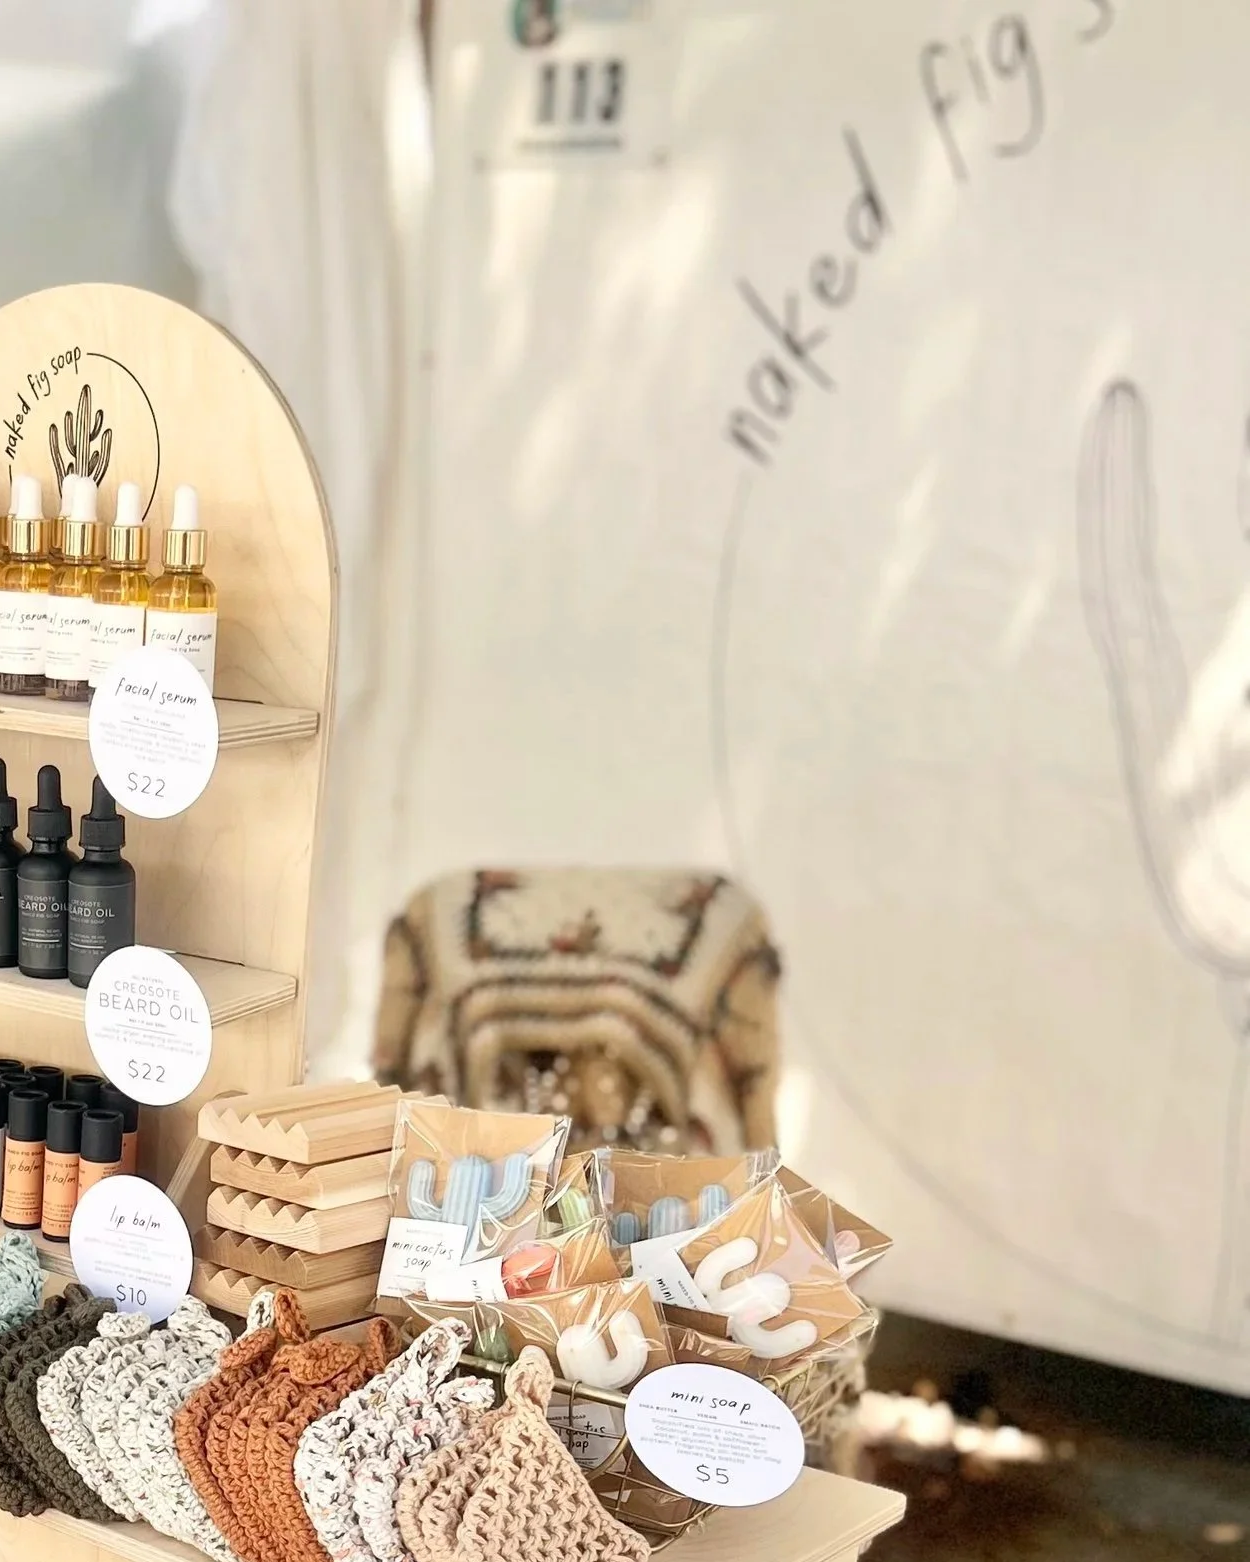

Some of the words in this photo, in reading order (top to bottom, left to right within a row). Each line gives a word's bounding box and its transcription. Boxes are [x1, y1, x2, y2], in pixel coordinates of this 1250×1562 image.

[724, 124, 894, 467] naked
[921, 13, 1044, 182] fig
[2, 392, 31, 460] naked
[27, 371, 51, 401] fig
[50, 346, 81, 375] soap
[150, 628, 183, 644] facial
[115, 677, 158, 701] facial
[159, 691, 197, 706] serum
[127, 771, 166, 798] $22
[51, 903, 67, 912] OIL
[69, 904, 92, 918] EARD
[95, 908, 116, 918] OIL
[113, 980, 181, 1002] CREOSOTE
[99, 992, 161, 1017] BEARD
[169, 1004, 201, 1024] OIL
[127, 1058, 166, 1083] $22
[18, 1159, 41, 1174] balm
[52, 1171, 76, 1186] balm
[109, 1205, 125, 1229] lip
[132, 1211, 161, 1231] balm
[392, 1241, 413, 1250] mini
[415, 1241, 455, 1260] cactus
[403, 1257, 432, 1272] soap
[116, 1284, 147, 1306] $10
[656, 1278, 675, 1301] mini
[670, 1391, 704, 1404] mini
[709, 1397, 751, 1416] soap
[696, 1464, 730, 1485] $5
